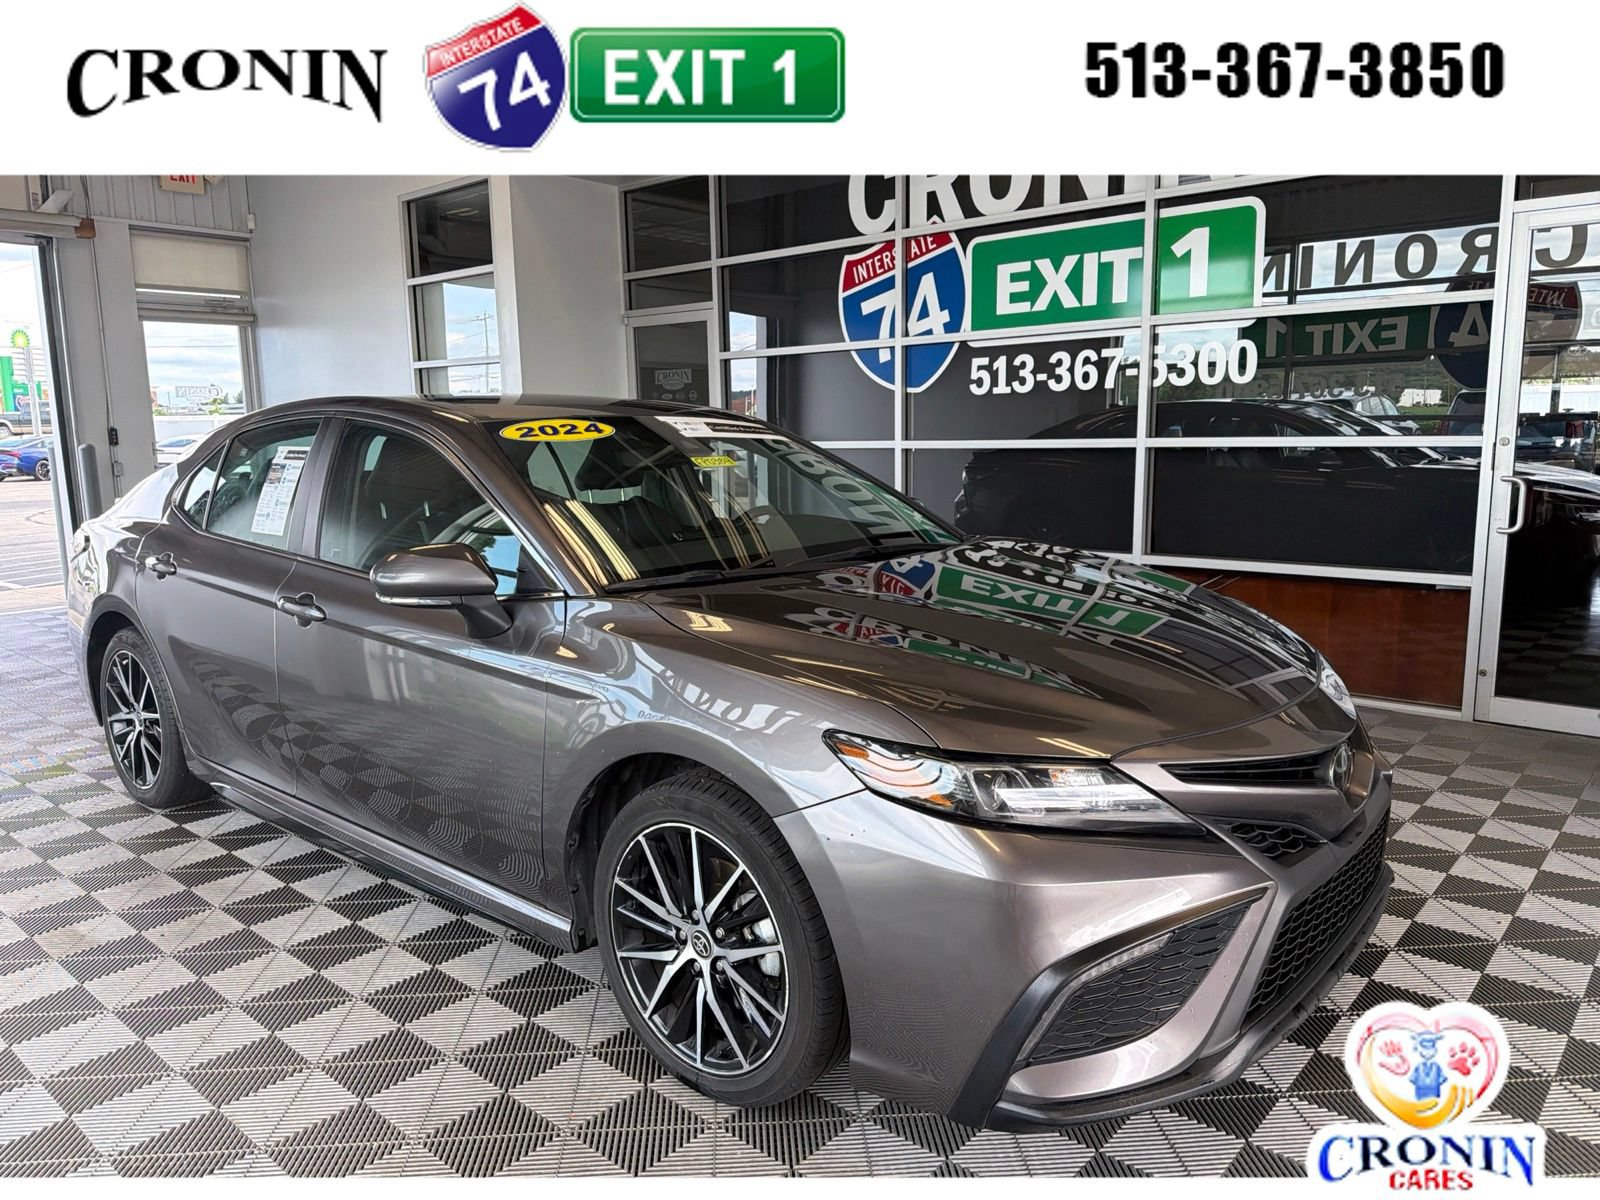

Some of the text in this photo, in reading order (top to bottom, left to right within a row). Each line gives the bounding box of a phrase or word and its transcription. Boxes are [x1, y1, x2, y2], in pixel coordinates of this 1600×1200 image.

[995, 226, 1210, 315] EXIT 1
[515, 423, 604, 438] 2024
